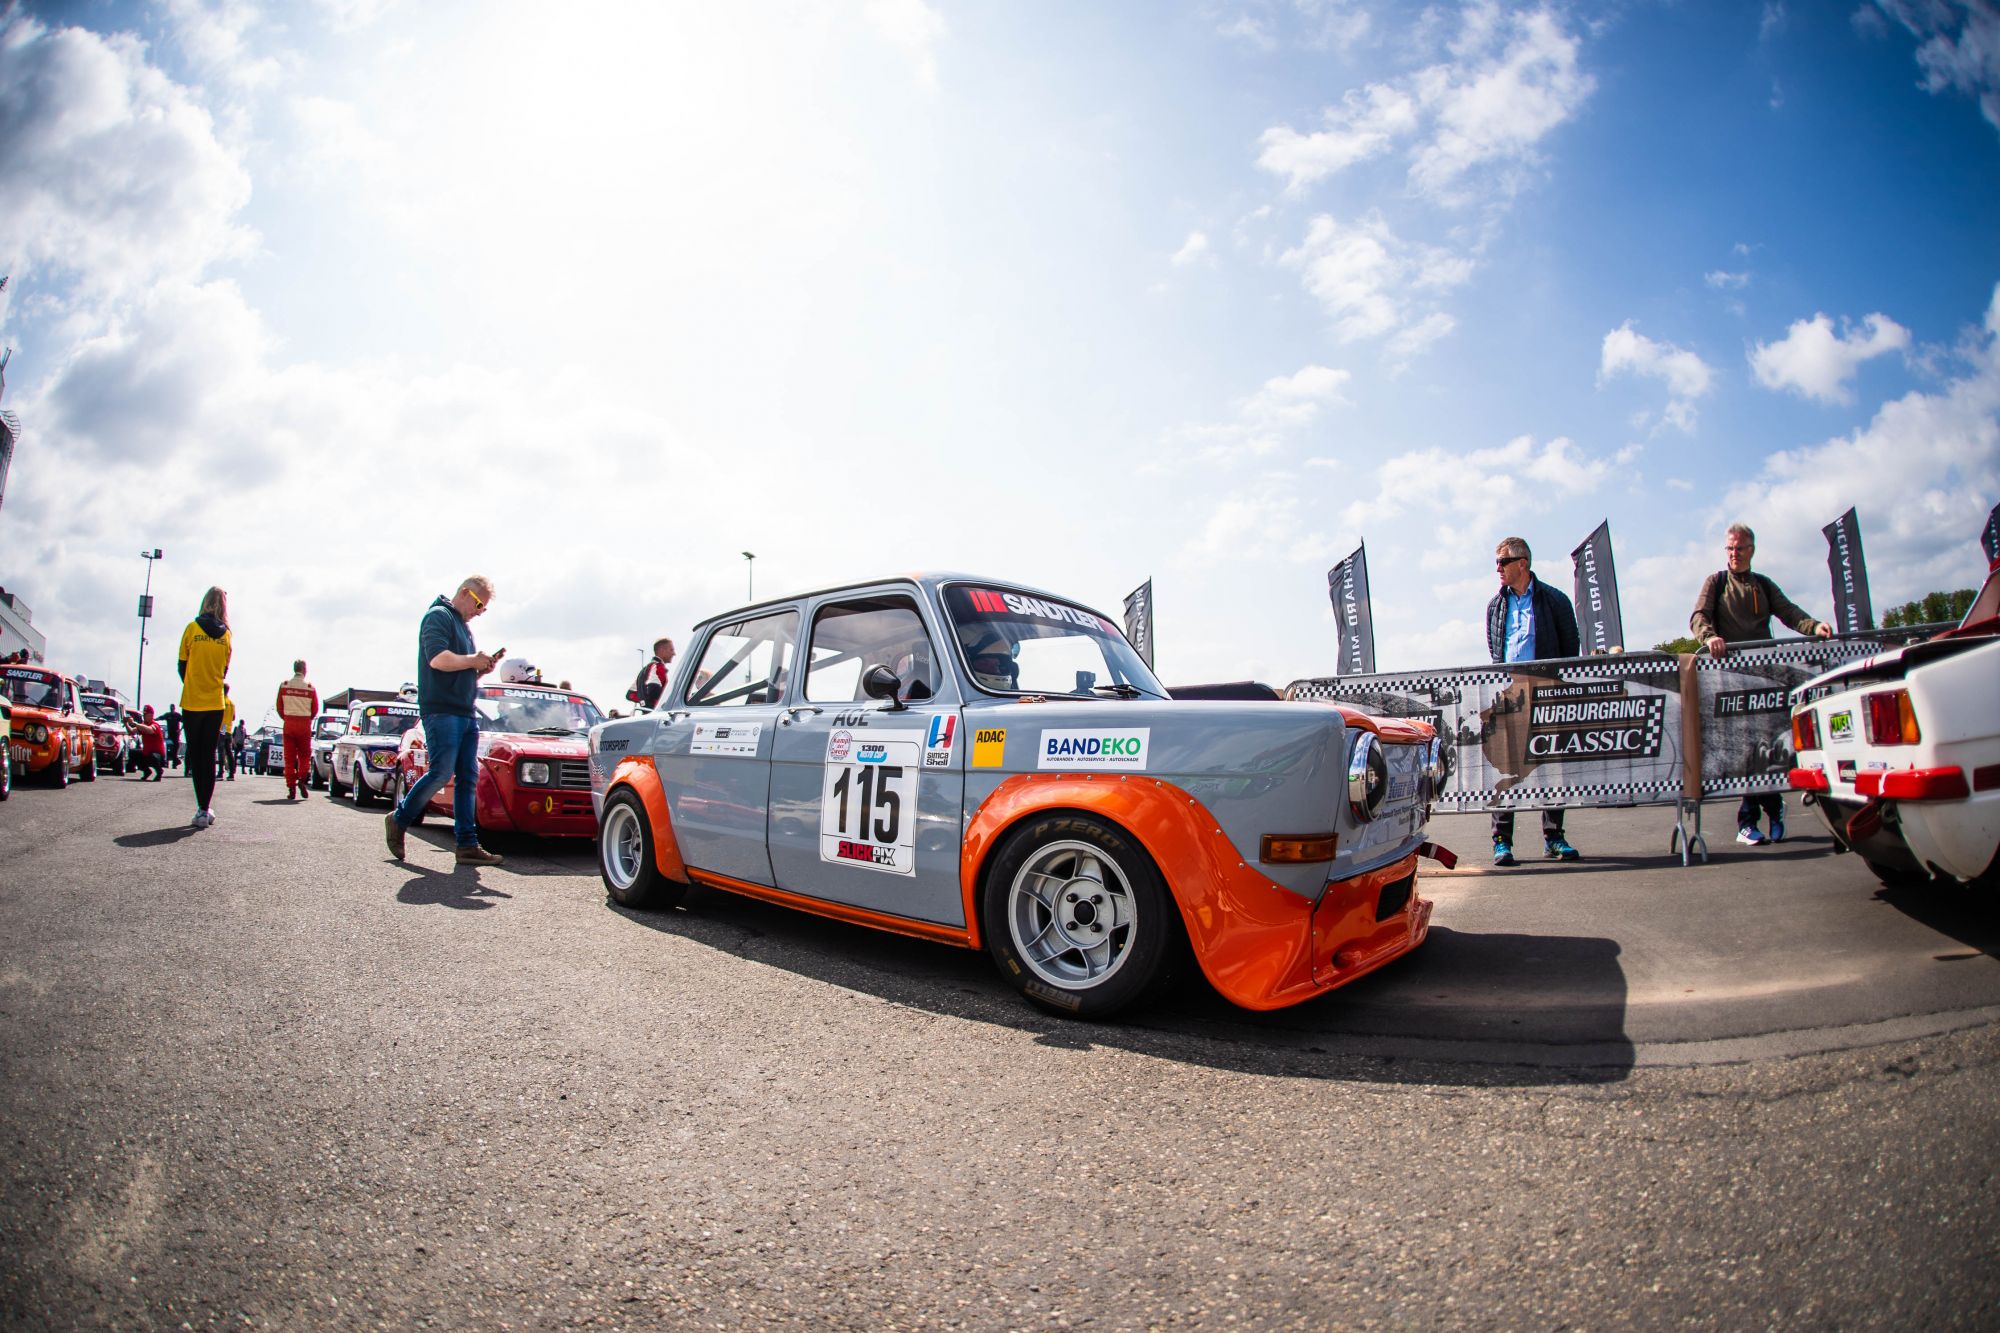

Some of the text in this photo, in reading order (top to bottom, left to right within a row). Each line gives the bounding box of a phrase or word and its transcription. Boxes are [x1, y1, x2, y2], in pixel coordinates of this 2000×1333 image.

[1002, 593, 1105, 632] SANDTLER
[6, 669, 43, 680] SANDTLER
[503, 689, 569, 702] SANDTLER
[1537, 684, 1619, 698] RICHARD MILLE
[1720, 695, 1745, 713] THE
[1748, 692, 1784, 710] RACE
[976, 731, 1004, 743] ADAC
[1046, 737, 1142, 756] BANDEKO
[1529, 729, 1643, 755] CLASSIC
[271, 750, 283, 761] 235
[834, 765, 903, 844] 115
[1034, 820, 1122, 848] P ZERO
